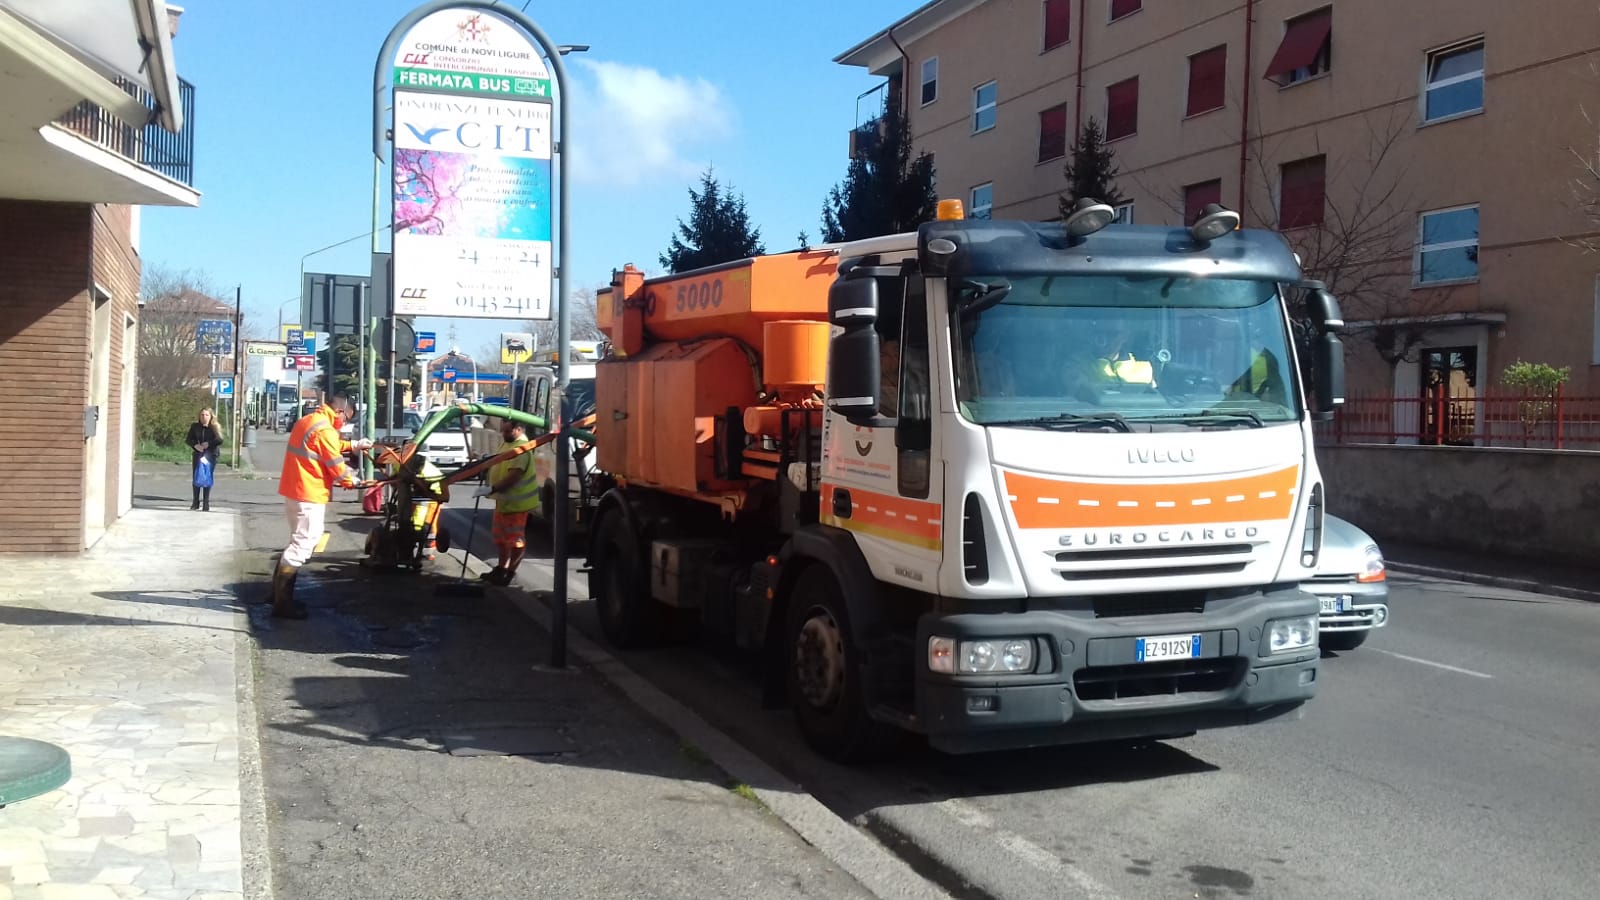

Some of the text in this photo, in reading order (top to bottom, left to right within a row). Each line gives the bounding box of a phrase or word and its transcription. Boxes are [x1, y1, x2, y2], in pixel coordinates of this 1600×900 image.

[415, 43, 458, 54] COMUNE
[471, 48, 496, 57] NOVI
[498, 50, 531, 60] LIGURE
[400, 71, 511, 92] FERMATA BUS
[676, 278, 723, 312] 5000
[220, 381, 230, 393] P
[1127, 447, 1194, 464] IVECO
[1058, 526, 1258, 546] EUROCARGO
